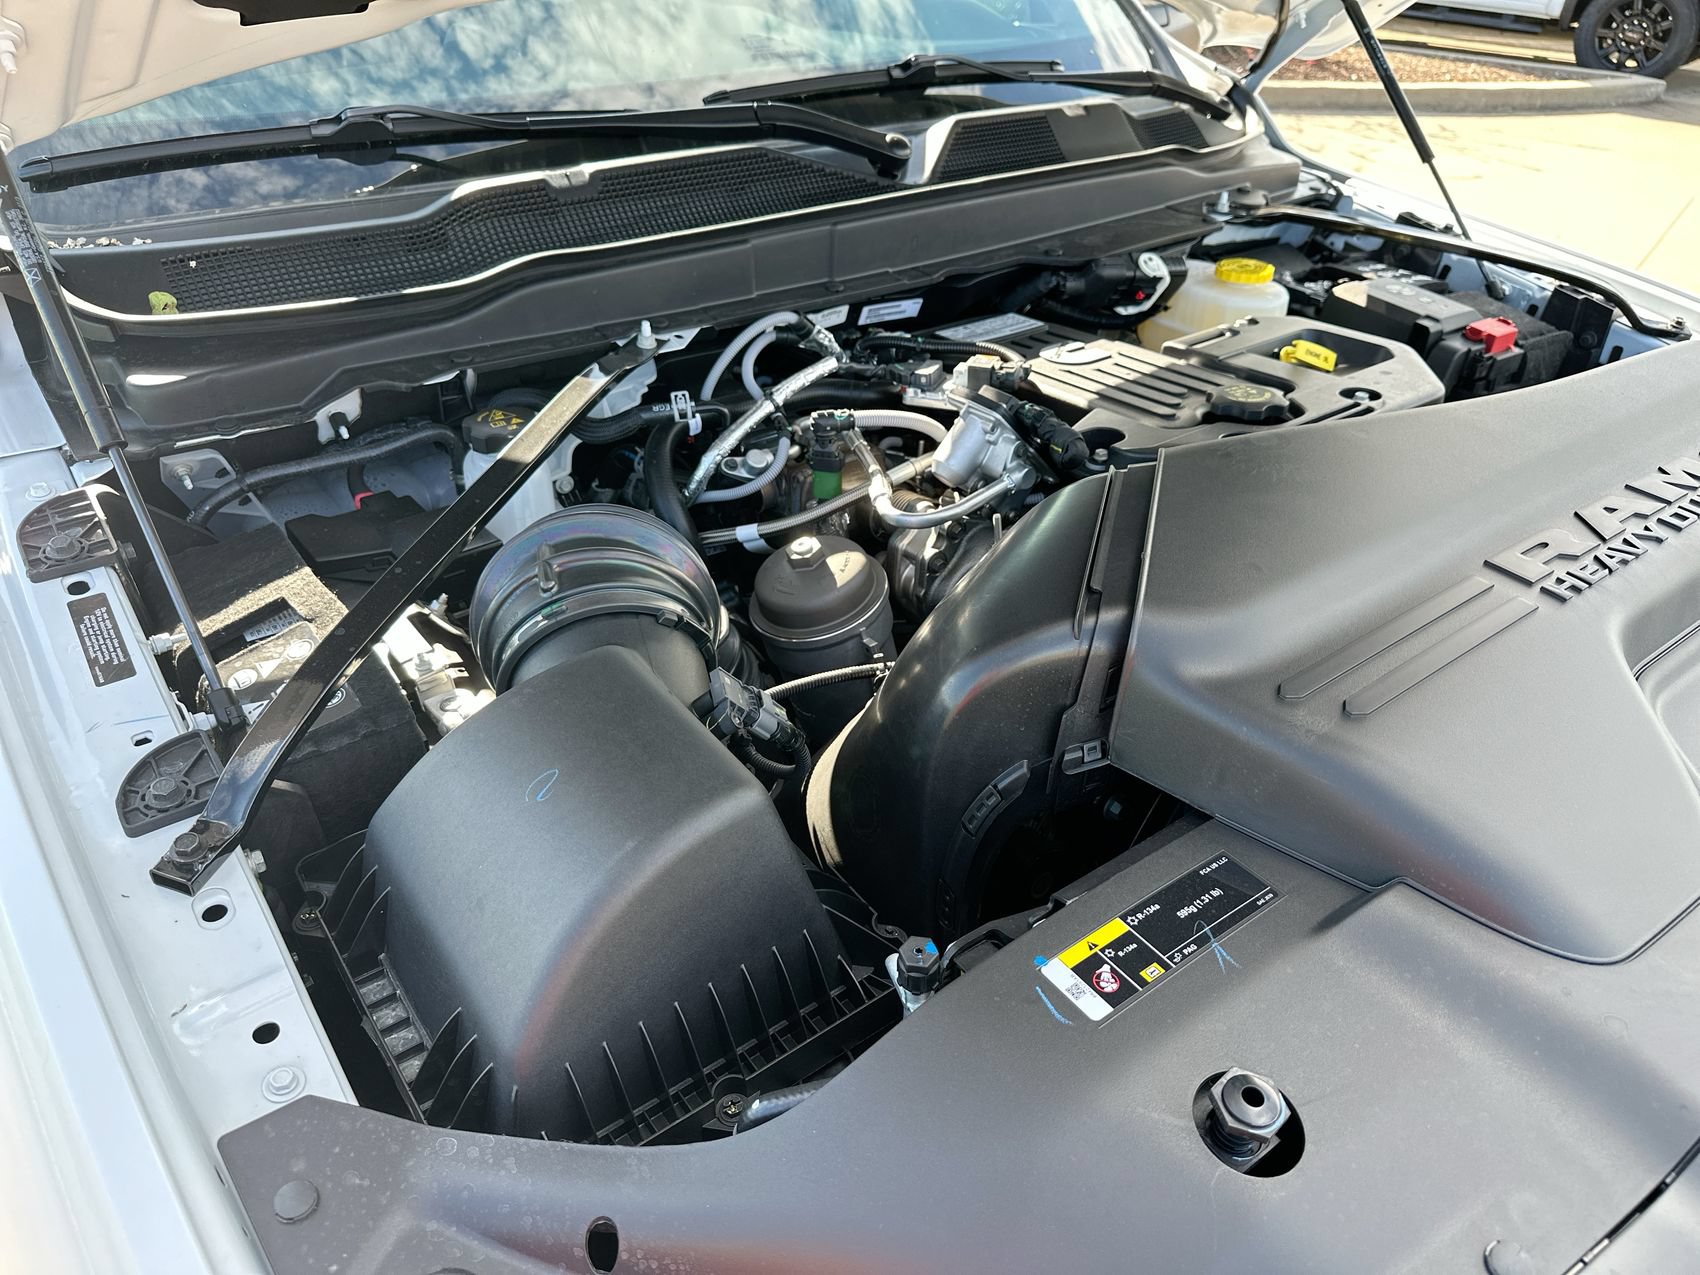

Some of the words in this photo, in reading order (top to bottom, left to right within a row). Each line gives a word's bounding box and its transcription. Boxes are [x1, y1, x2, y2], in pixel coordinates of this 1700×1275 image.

[1482, 457, 1700, 585] RAM
[1216, 856, 1228, 866] LLC
[1136, 902, 1161, 921] R-134a
[1176, 903, 1198, 919] 595g
[1194, 892, 1212, 909] (1.31
[1209, 887, 1224, 900] lb)
[1118, 943, 1138, 958] R-134a
[1182, 944, 1198, 956] PAG
